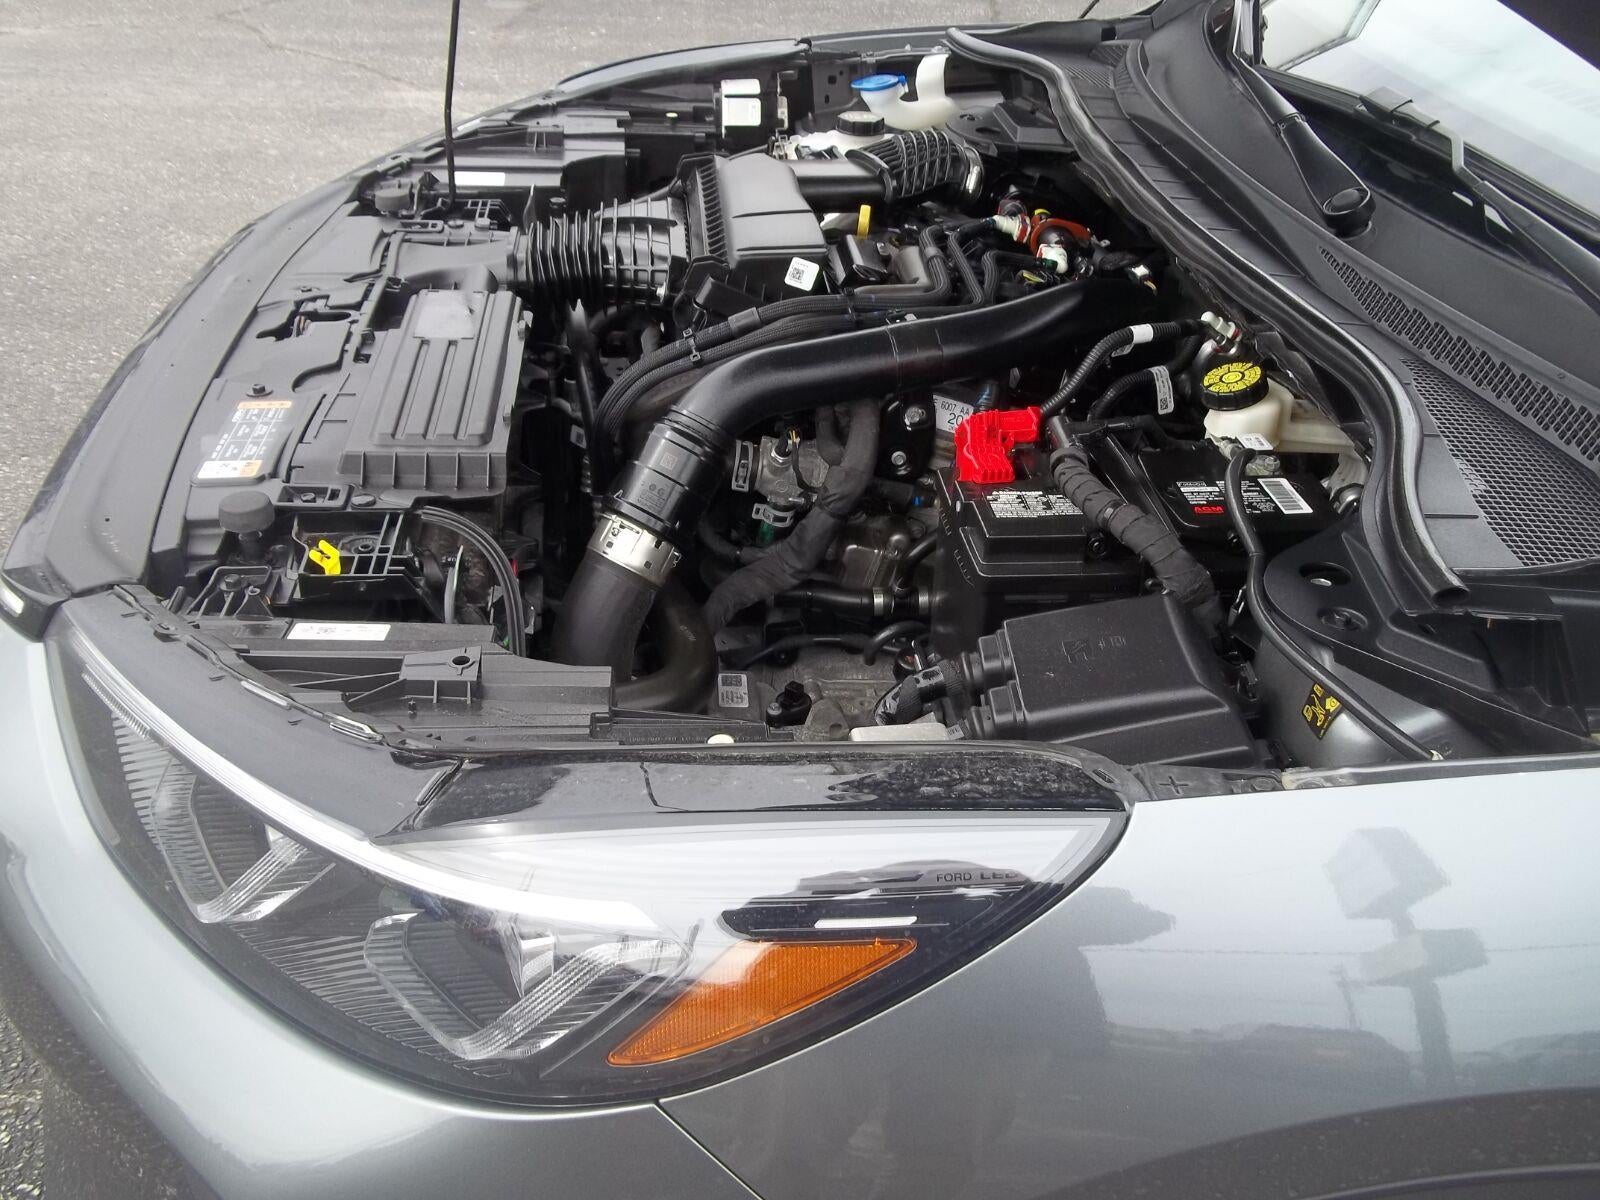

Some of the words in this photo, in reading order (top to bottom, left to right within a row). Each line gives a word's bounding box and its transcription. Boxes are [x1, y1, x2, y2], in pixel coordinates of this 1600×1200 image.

[940, 400, 956, 412] 6007
[960, 406, 970, 416] AA
[947, 412, 963, 426] 20
[936, 872, 972, 882] FORD
